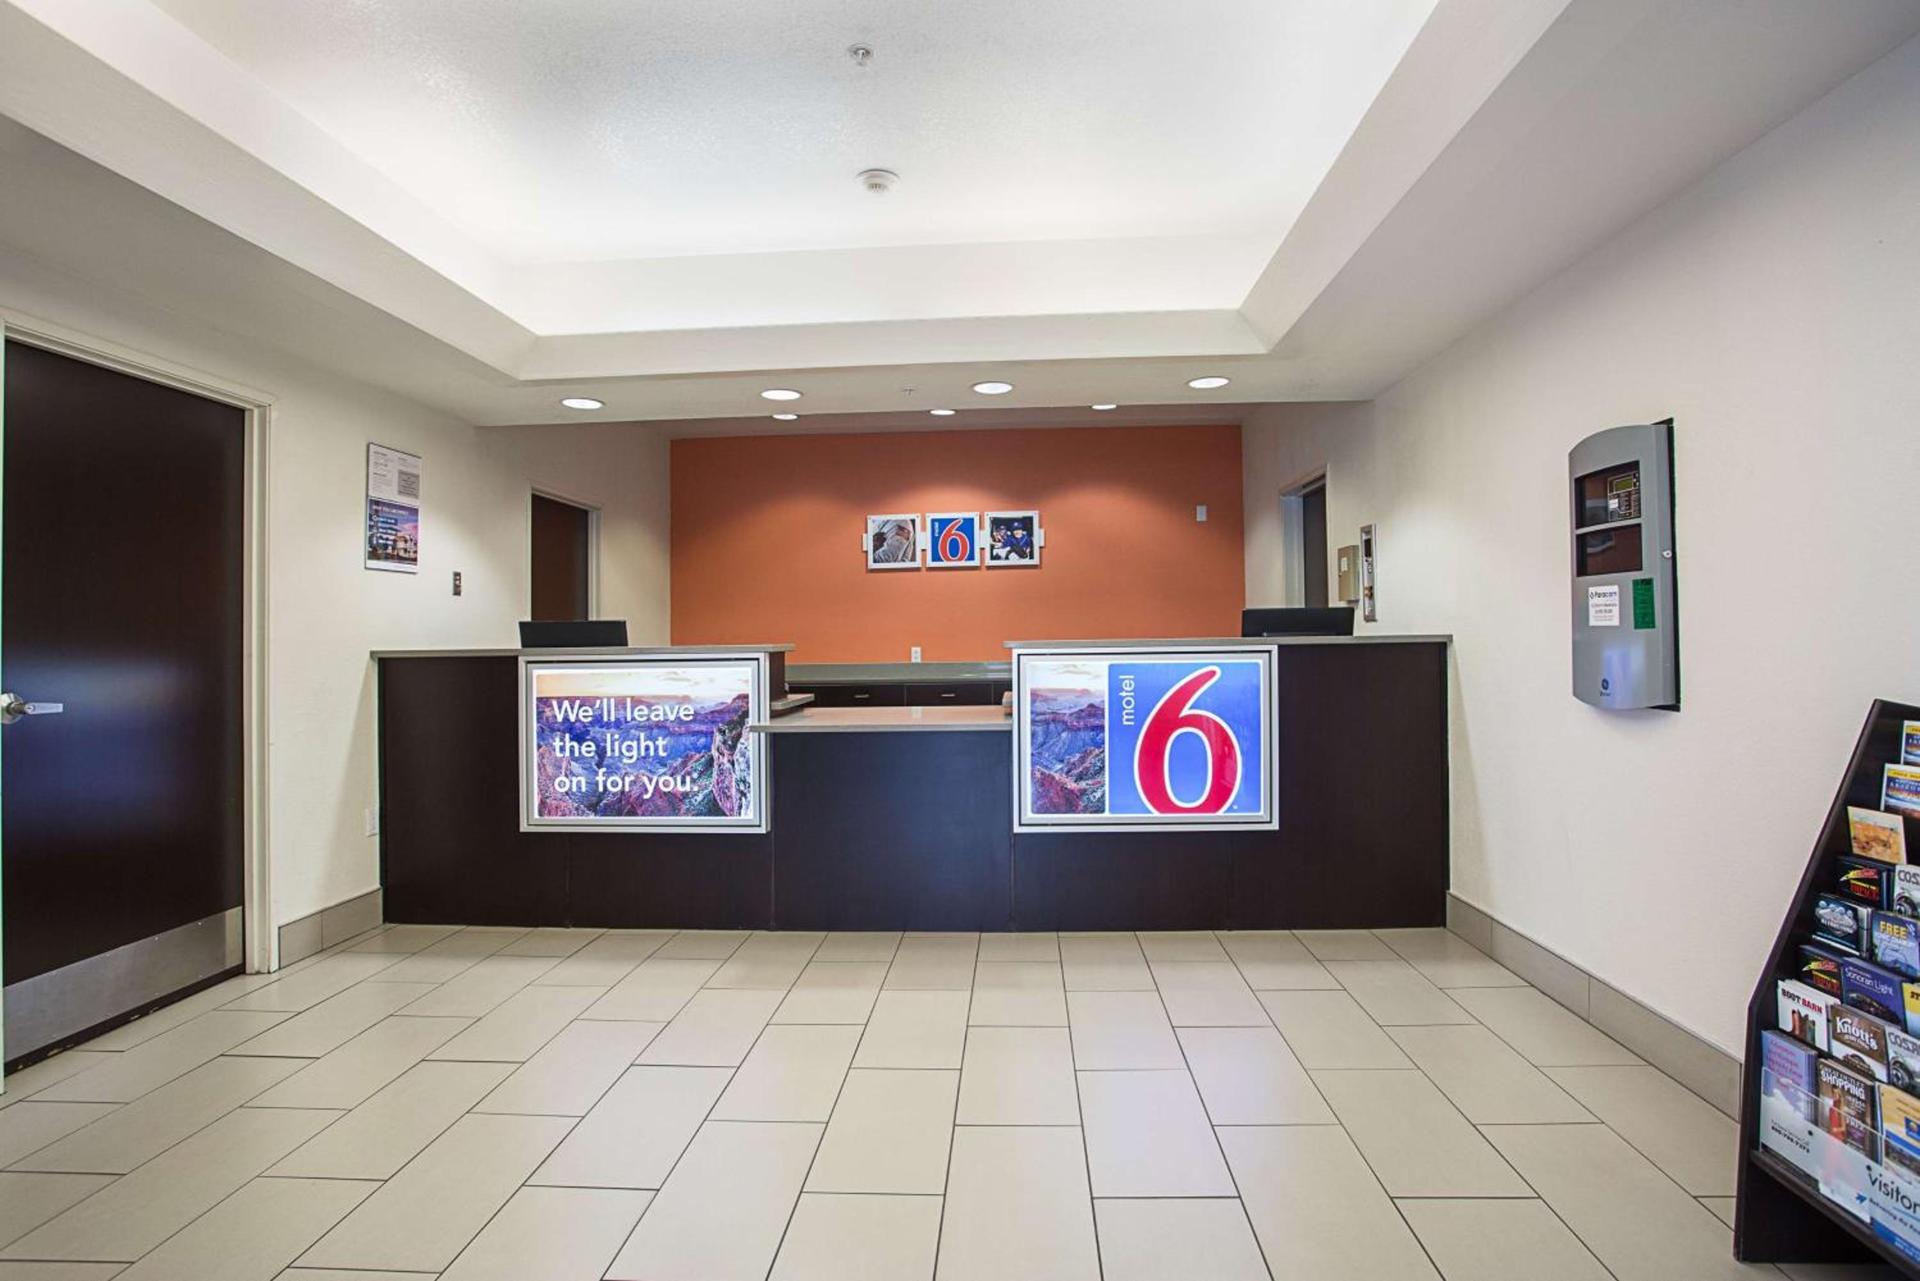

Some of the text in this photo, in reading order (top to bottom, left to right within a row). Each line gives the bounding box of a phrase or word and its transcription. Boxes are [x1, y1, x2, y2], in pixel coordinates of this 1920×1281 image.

[938, 518, 970, 562] 6
[552, 697, 695, 723] We'll leave
[1119, 674, 1135, 725] motel
[553, 733, 668, 764] the light
[1133, 665, 1242, 816] 6
[554, 768, 699, 798] on for you.
[1898, 869, 1920, 886] COS
[1880, 920, 1909, 939] FREE
[1836, 1016, 1879, 1050] Knott's
[1888, 1031, 1920, 1055] COSA
[1820, 1070, 1865, 1100] SHOPPING
